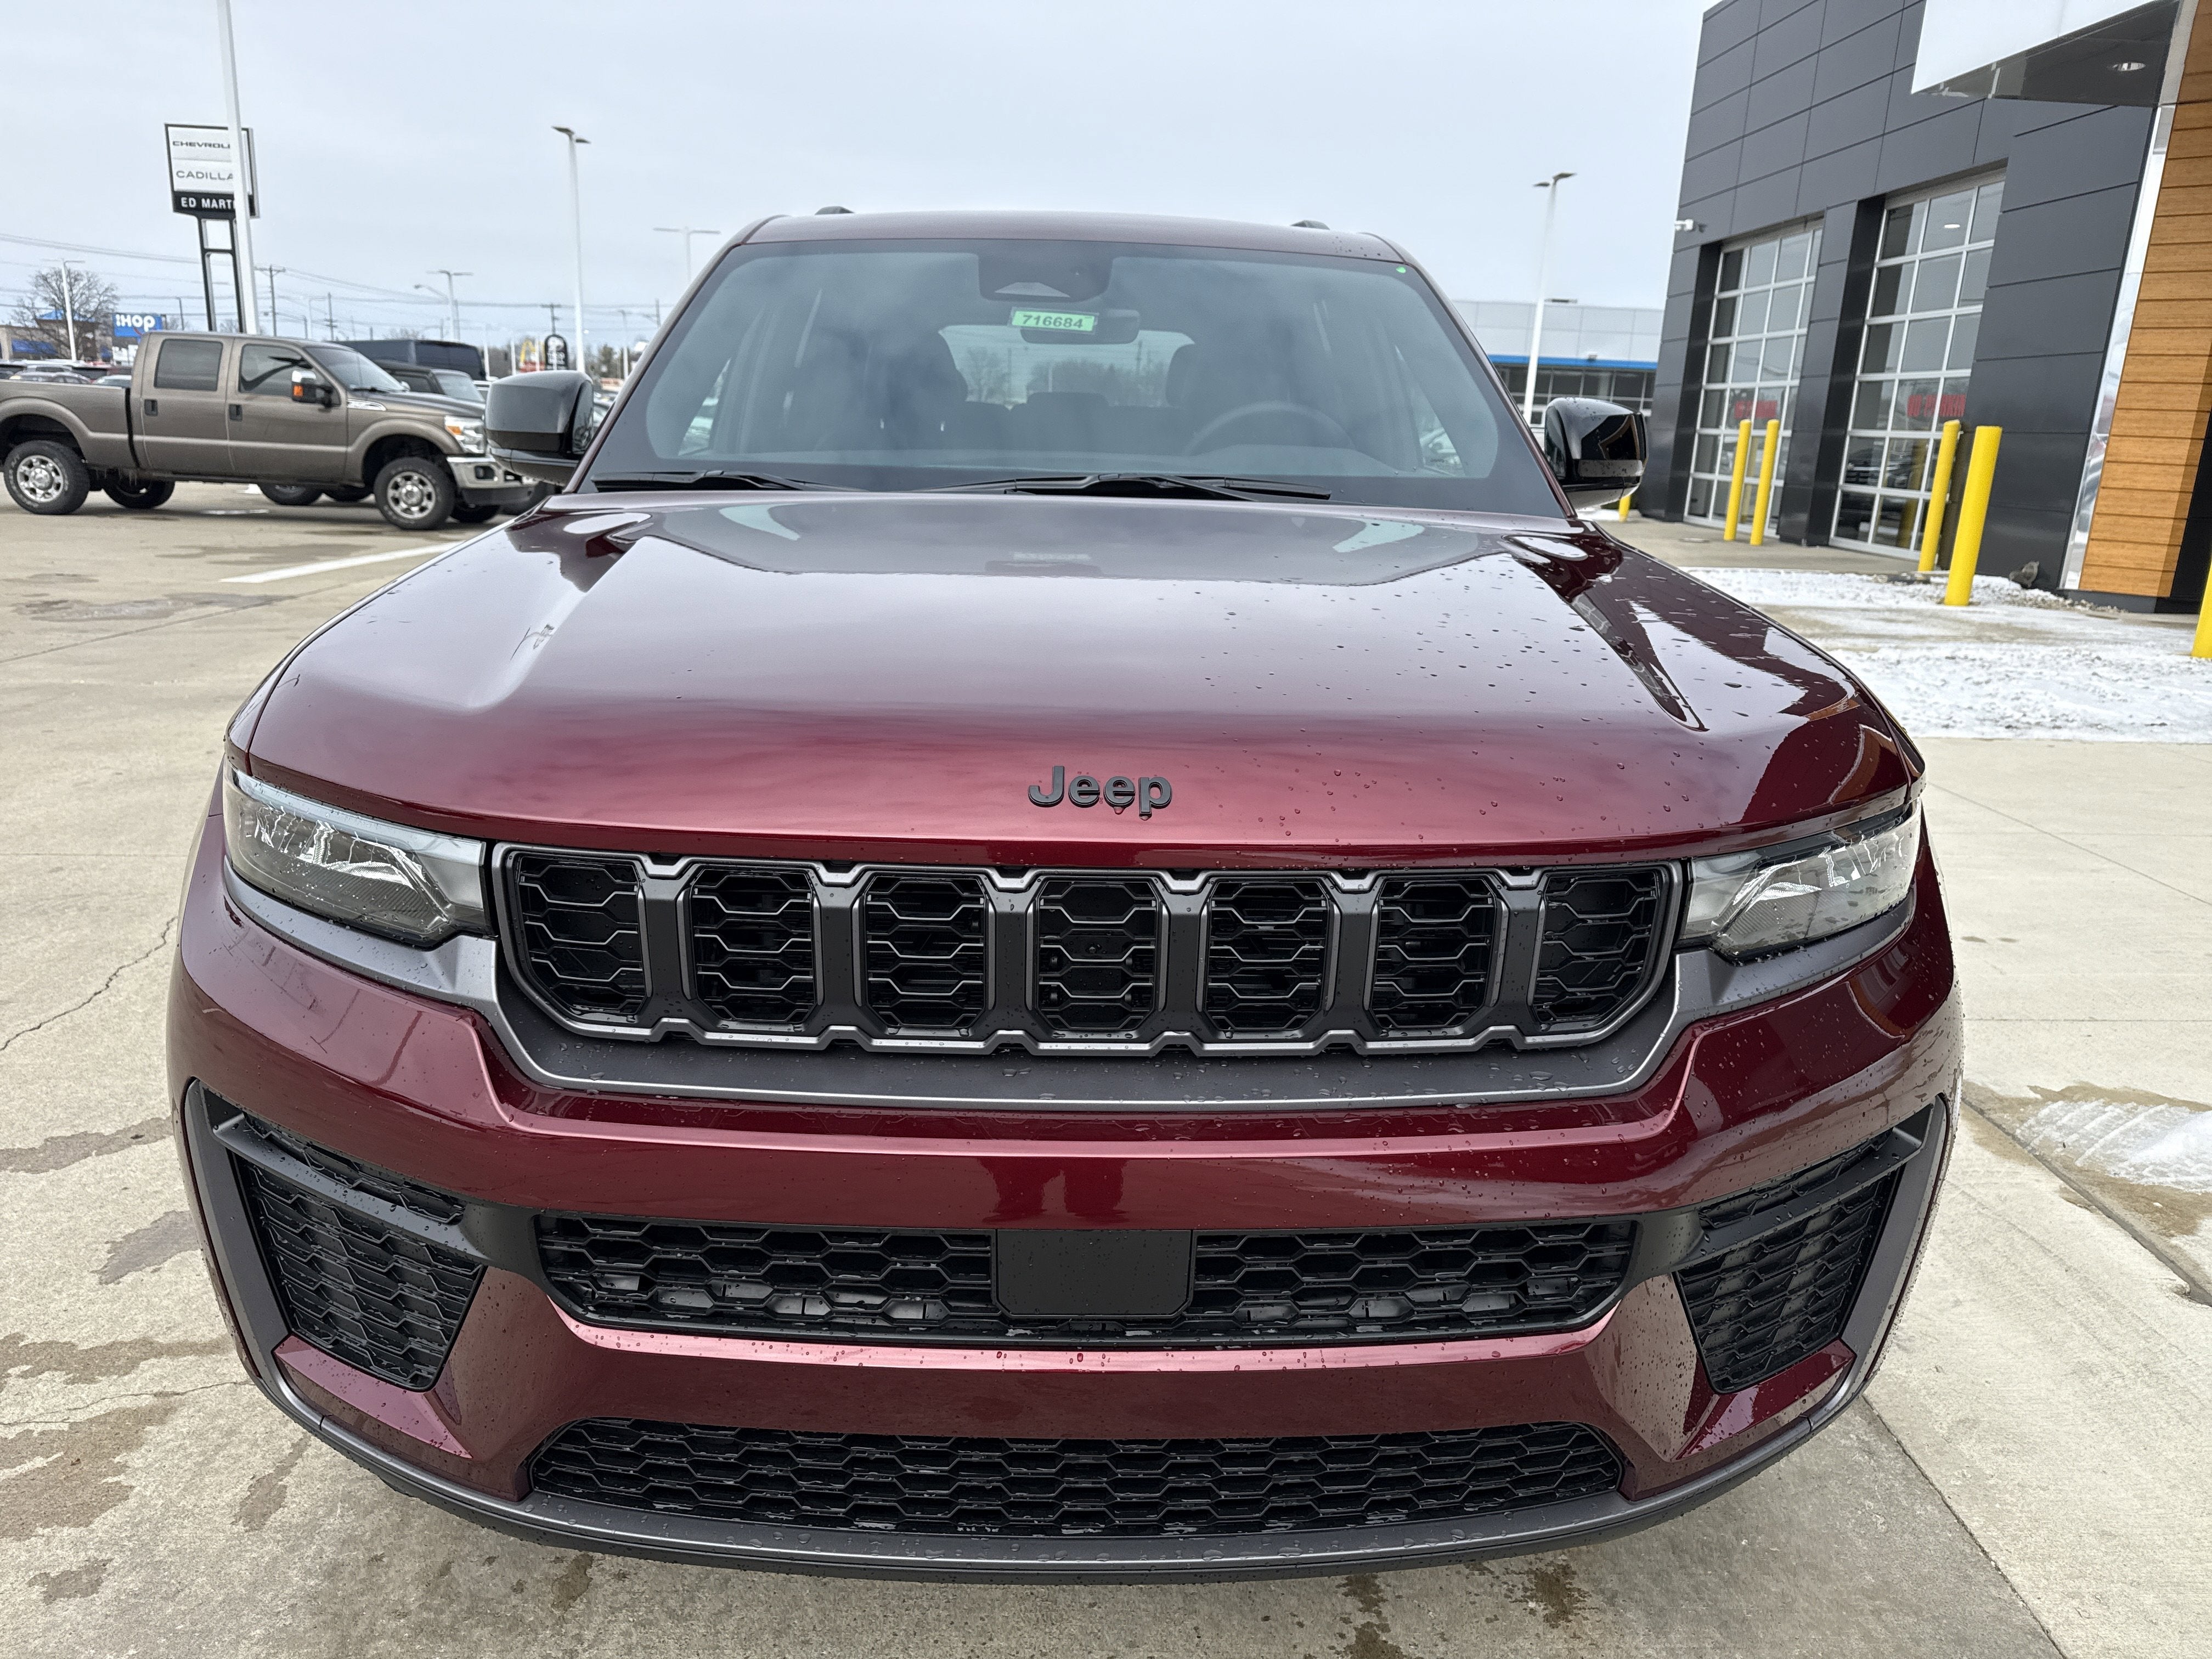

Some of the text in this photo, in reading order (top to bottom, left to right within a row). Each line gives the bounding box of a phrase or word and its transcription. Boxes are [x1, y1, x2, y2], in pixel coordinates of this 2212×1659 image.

[172, 140, 230, 149] CHEVROL
[176, 171, 234, 180] CADILLA
[181, 197, 235, 210] ED MART
[1023, 314, 1083, 329] 716684
[1028, 765, 1172, 815] Jeep
